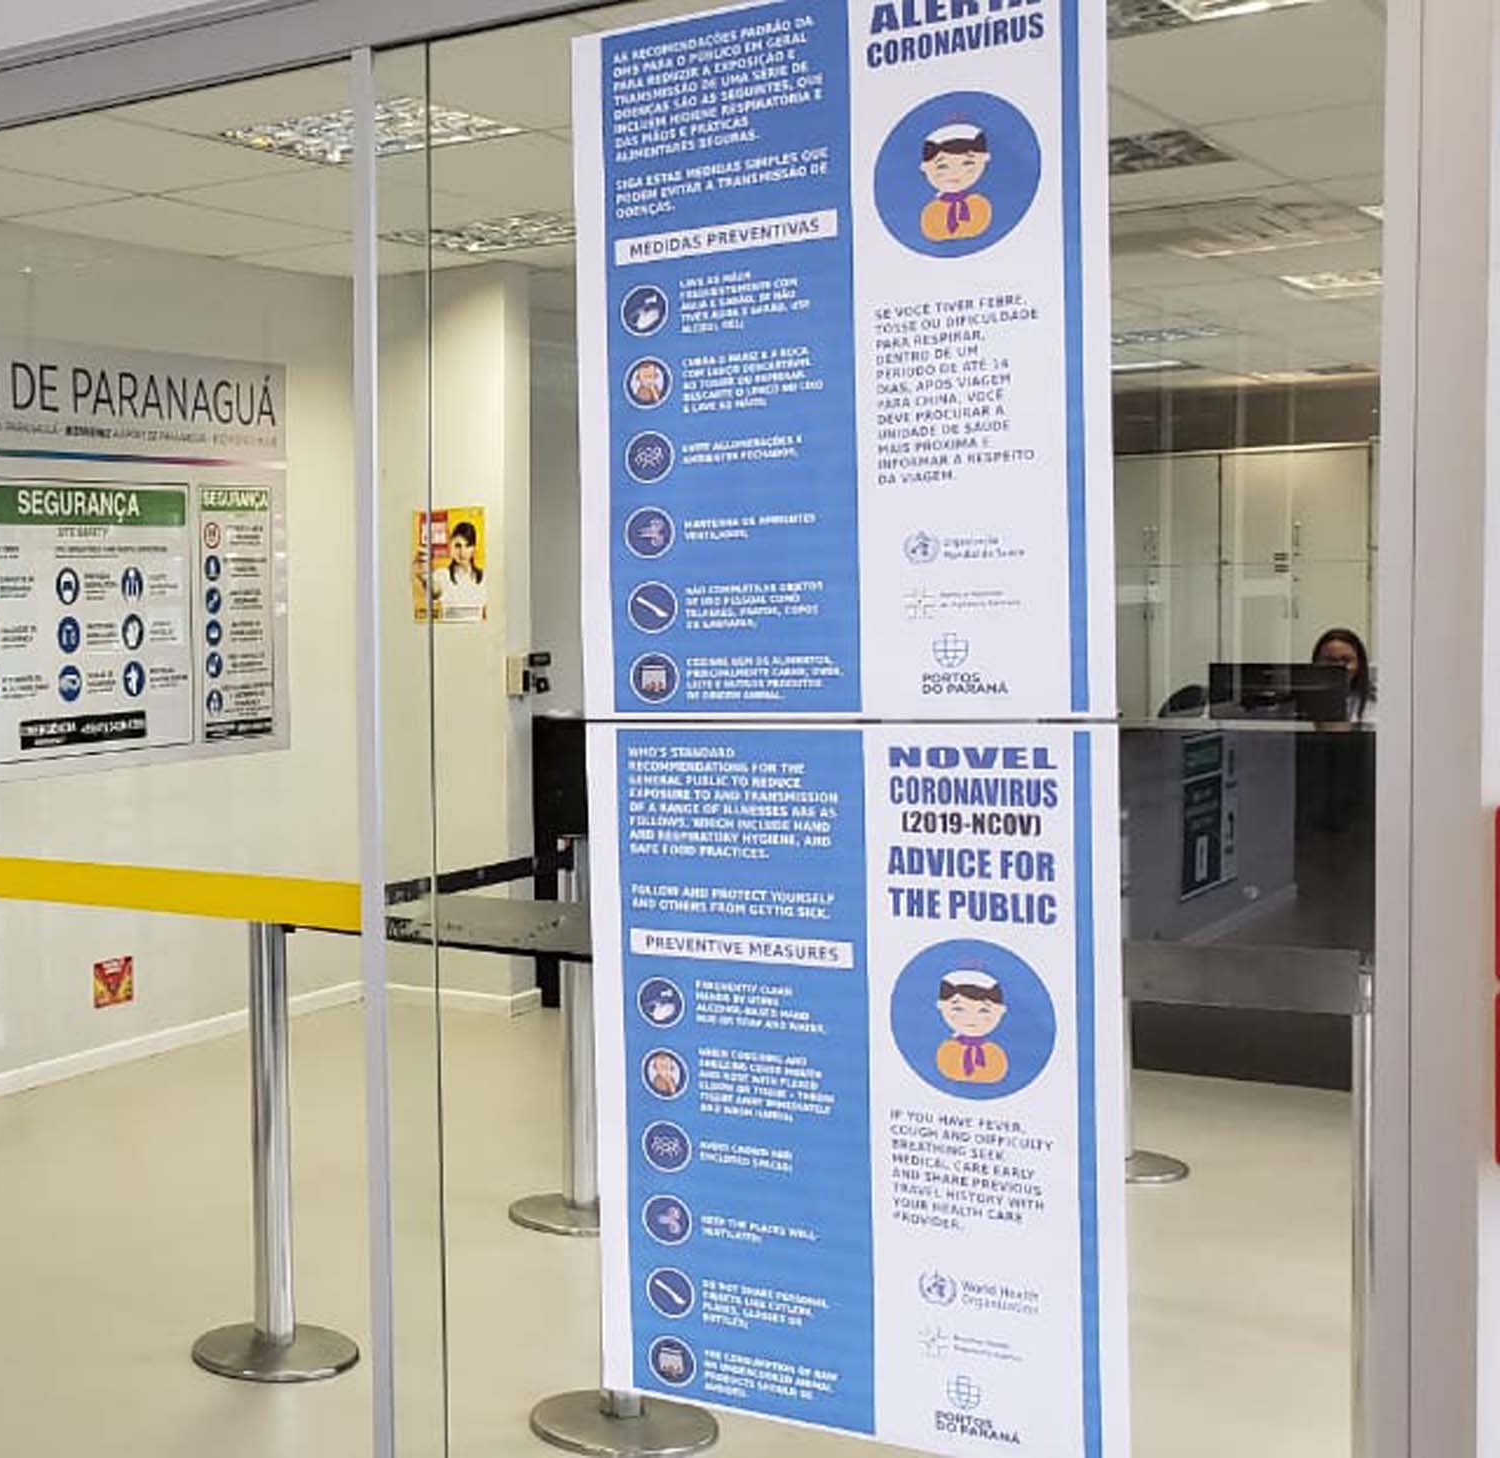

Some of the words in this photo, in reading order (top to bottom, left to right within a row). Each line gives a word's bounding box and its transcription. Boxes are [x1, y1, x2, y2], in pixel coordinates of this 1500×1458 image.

[867, 9, 1044, 68] CORONAVÍRUS
[630, 235, 701, 257] MEDIDAS
[707, 218, 818, 247] PREVENTIVAS
[10, 363, 61, 413] DE
[72, 367, 277, 427] PARANAGUÁ
[17, 489, 141, 523] SEGURANÇA
[922, 673, 980, 682] PORTOS
[922, 684, 941, 694] DO
[947, 683, 1008, 694] PARANÁ
[888, 747, 1057, 769] NOVEL
[890, 776, 1058, 808] CORONAVIRUS
[902, 811, 1041, 836] (2019-NCOV)
[888, 846, 990, 879] ADVICE
[1000, 849, 1055, 882] FOR
[888, 888, 939, 919] THE
[949, 890, 1057, 925] PUBLIC
[646, 935, 742, 955] PREVENTIVE
[748, 942, 838, 961] MEASURES
[935, 1410, 993, 1430] PORTOS
[936, 1420, 956, 1431] DO
[961, 1425, 1021, 1444] PARANÁ
